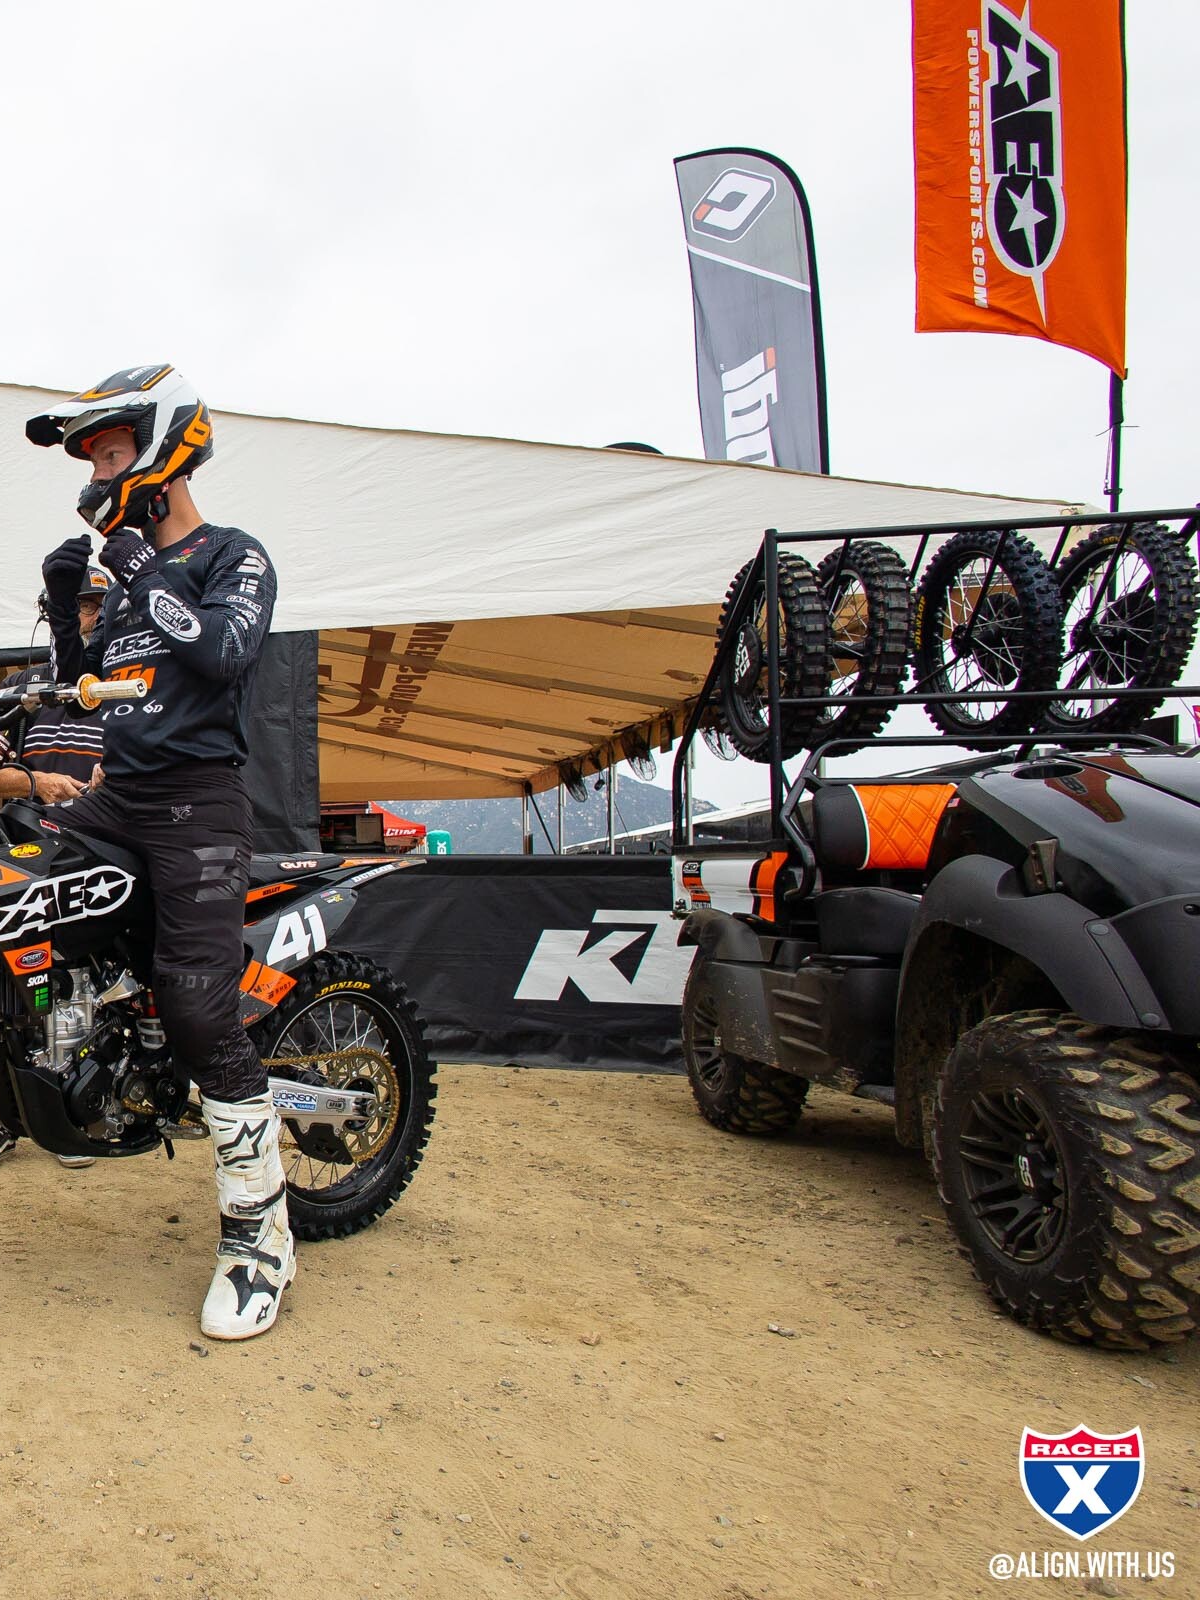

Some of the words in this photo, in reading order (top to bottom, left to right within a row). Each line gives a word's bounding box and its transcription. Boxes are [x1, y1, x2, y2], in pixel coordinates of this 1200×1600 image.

[983, 2, 1065, 274] AEO
[966, 28, 989, 308] POWERSPORTS.COM
[121, 545, 156, 583] SHOT
[279, 860, 318, 870] GUTS
[350, 863, 395, 883] DUNLOP
[262, 886, 281, 897] KELLEY
[265, 903, 328, 967] 41
[512, 908, 699, 1006] KT
[26, 973, 49, 988] SKDA
[318, 981, 373, 998] DUNLOP
[273, 1089, 318, 1103] JÖRNSON
